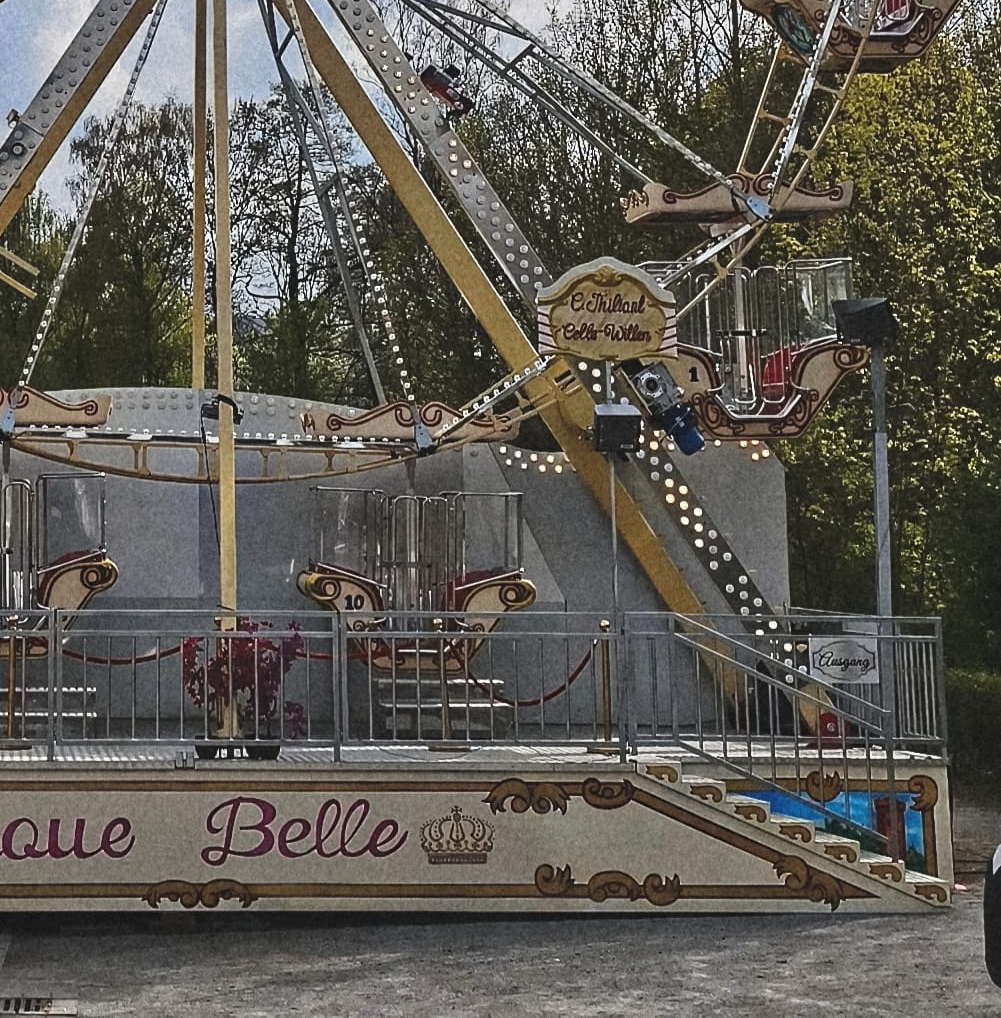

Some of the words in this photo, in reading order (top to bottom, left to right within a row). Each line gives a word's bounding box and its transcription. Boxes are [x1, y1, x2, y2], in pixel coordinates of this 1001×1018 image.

[689, 366, 699, 383] 1
[344, 594, 365, 611] 10
[819, 651, 871, 672] Ausgang
[200, 796, 409, 867] Belle
